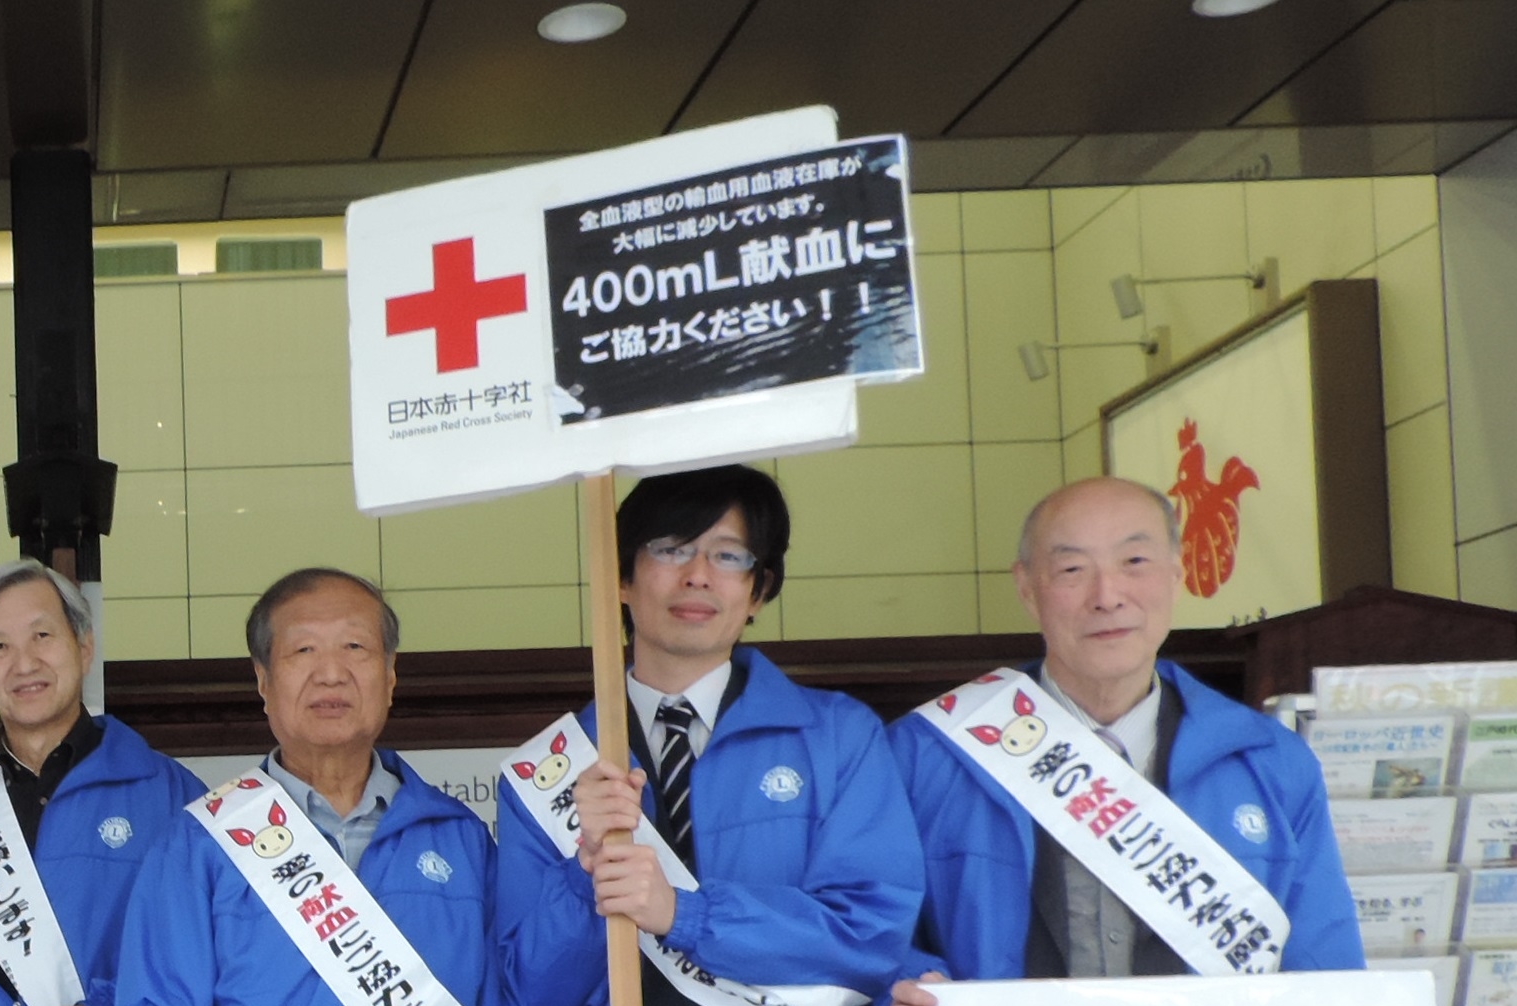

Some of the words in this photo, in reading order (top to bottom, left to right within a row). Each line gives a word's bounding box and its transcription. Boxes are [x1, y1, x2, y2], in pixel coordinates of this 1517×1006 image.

[579, 155, 863, 232] 全血液型の輸血用血液在庫が
[613, 201, 825, 254] 大幅に減少しています。
[562, 219, 898, 318] 400mL献血に
[388, 379, 533, 425] 日本赤十字社
[388, 424, 438, 440] Japanese
[441, 418, 460, 431] Red
[463, 416, 492, 428] Cross
[494, 408, 533, 423] Society
[442, 774, 498, 803] tabl
